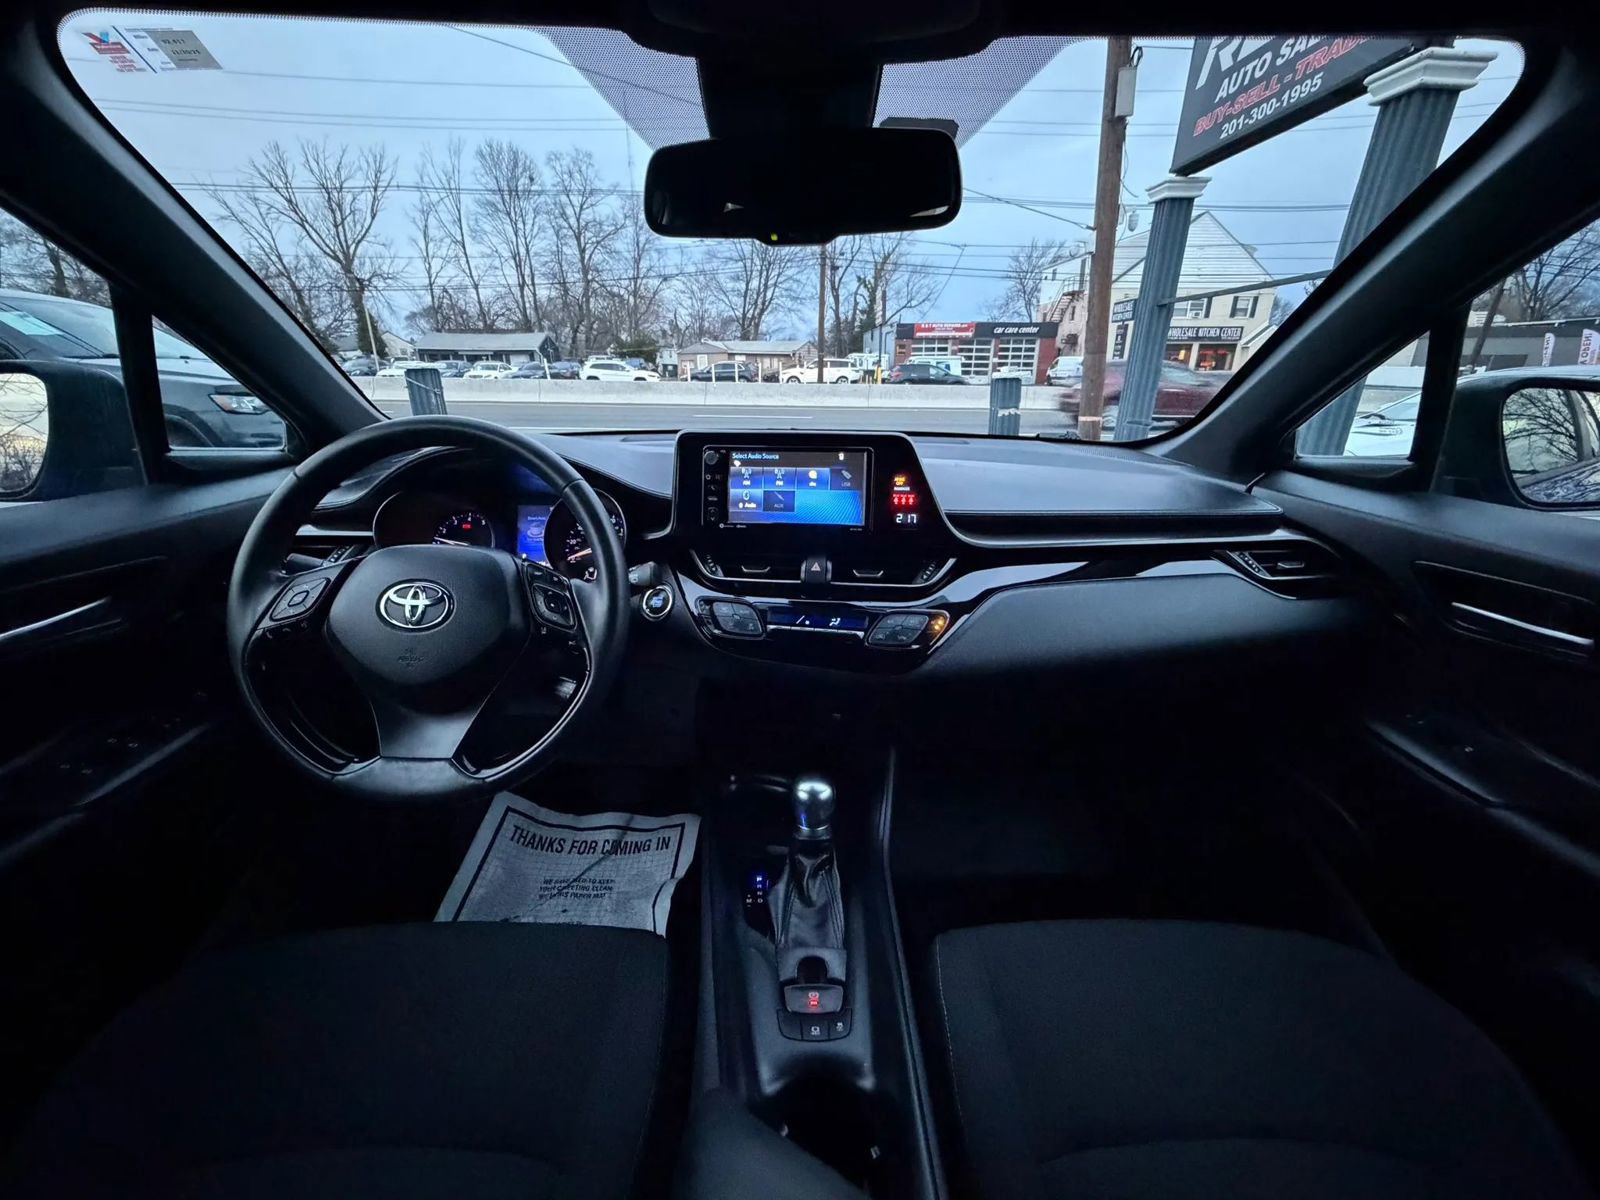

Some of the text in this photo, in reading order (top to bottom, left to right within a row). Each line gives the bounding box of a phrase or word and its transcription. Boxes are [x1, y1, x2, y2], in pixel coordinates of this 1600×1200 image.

[1214, 50, 1273, 103] AUTO
[1219, 72, 1324, 139] 201-300-1995
[993, 326, 1040, 334] car care center
[1198, 327, 1221, 337] KITCHEN
[1221, 327, 1242, 337] CENTER
[732, 452, 748, 460] Select
[509, 824, 671, 856] THANKS FOR COMING IN
